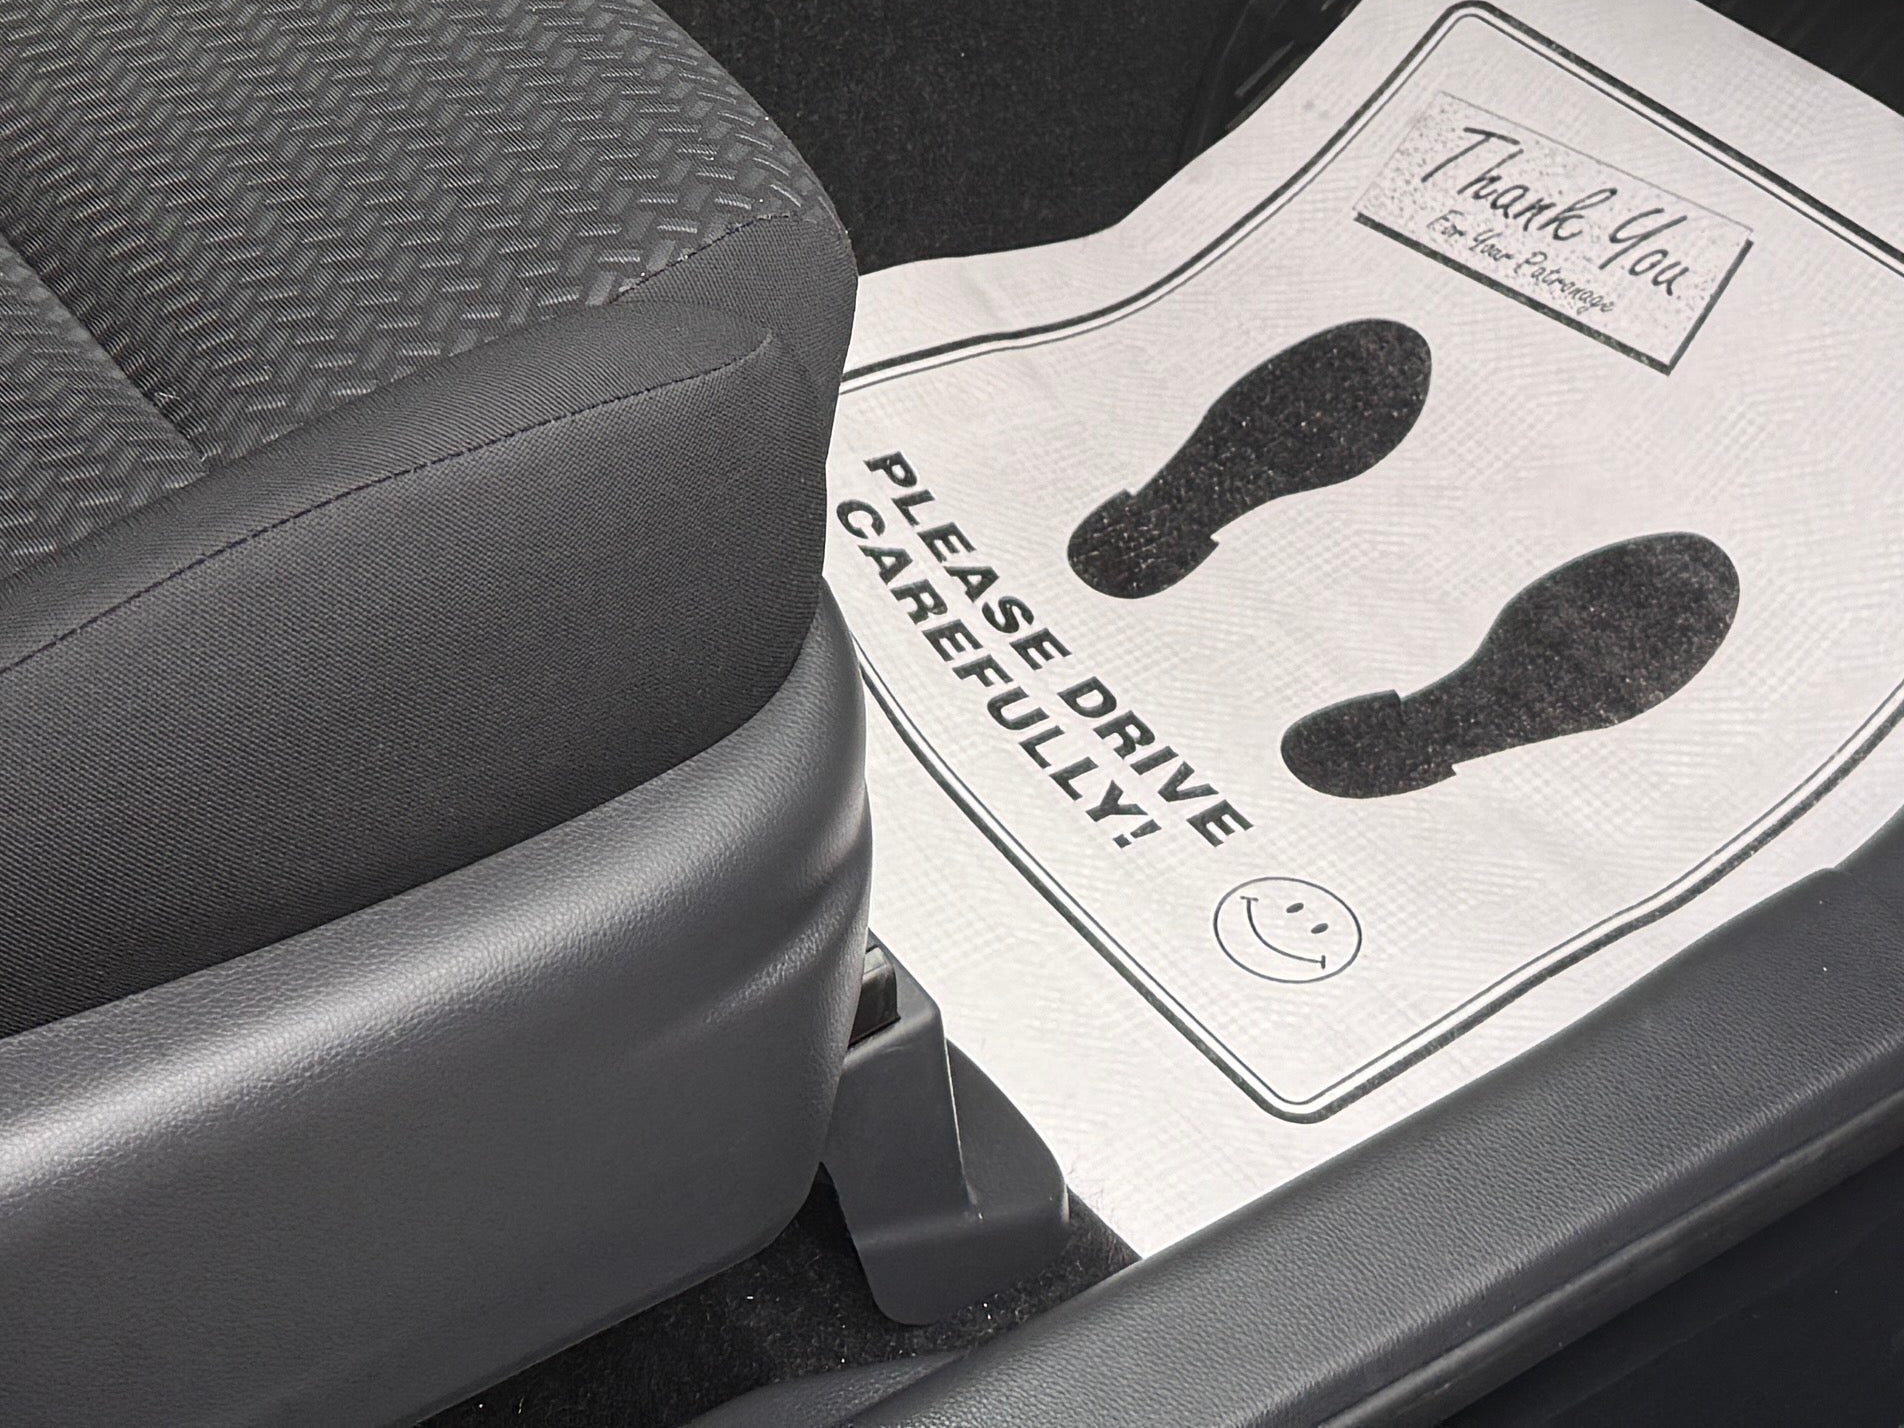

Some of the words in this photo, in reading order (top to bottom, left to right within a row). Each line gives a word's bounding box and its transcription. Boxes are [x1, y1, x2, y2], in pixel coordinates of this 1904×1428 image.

[1421, 126, 1618, 241] Thank
[1599, 208, 1691, 296] You
[1426, 209, 1466, 238] For
[1469, 228, 1514, 262] Your
[1513, 250, 1616, 315] Patronage
[836, 498, 1163, 849] CAREFULLY!
[863, 450, 1073, 671] PLEASE
[1056, 675, 1255, 848] DRIVE
